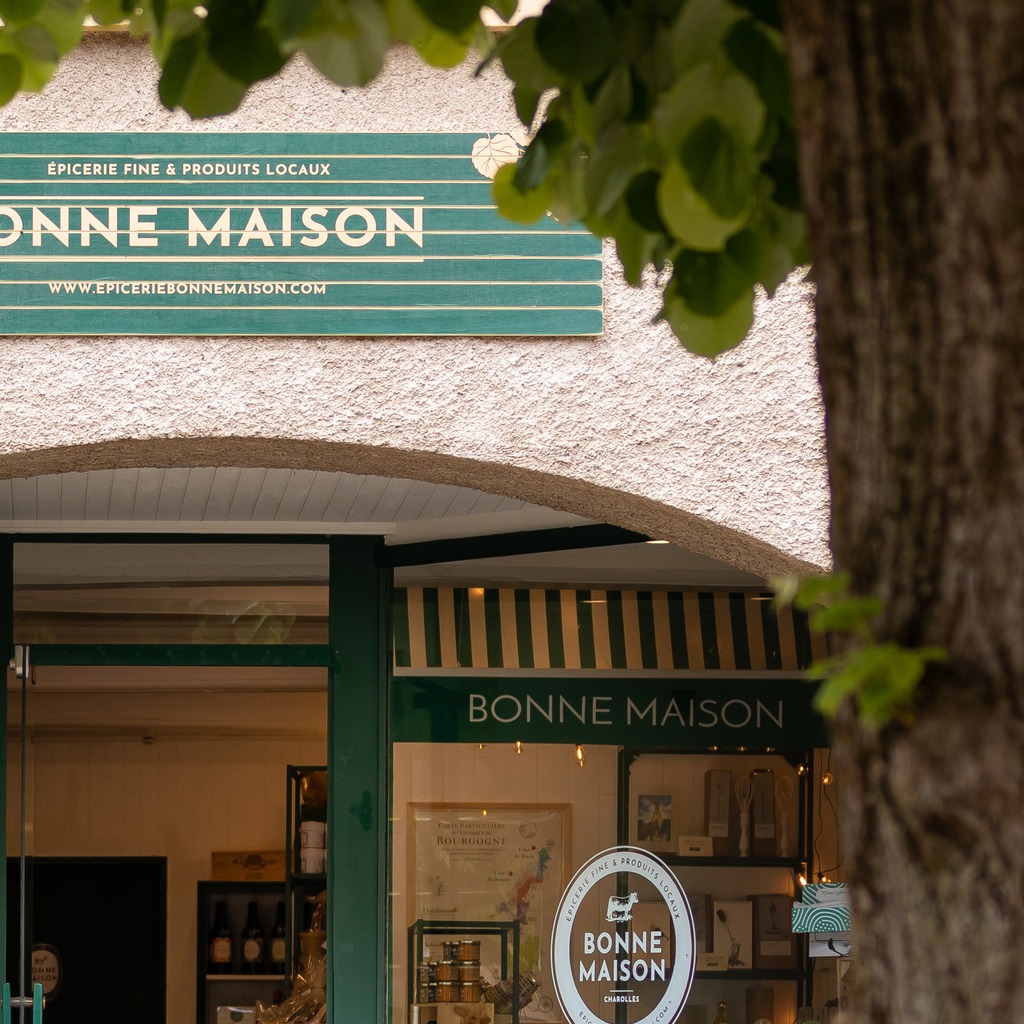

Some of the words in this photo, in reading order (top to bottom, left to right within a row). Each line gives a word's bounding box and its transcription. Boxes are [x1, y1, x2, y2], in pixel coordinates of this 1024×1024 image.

[47, 161, 118, 176] ÉPICERIE
[123, 163, 162, 176] FINE
[165, 163, 177, 176] &
[182, 163, 260, 176] PRODUITS
[266, 163, 331, 176] LOCAUX
[188, 207, 424, 248] MAISON
[48, 282, 327, 295] WWW.EPICERIEBONNEMAISON.COM
[469, 694, 613, 725] BONNE
[626, 696, 784, 729] MAISON
[591, 861, 609, 878] FINE
[612, 858, 618, 867] &
[620, 857, 659, 880] PRODUITS
[659, 879, 681, 920] LOCAUX
[584, 930, 662, 955] BONNE
[578, 958, 666, 982] MAISON
[603, 995, 640, 1003] CHAROLLES
